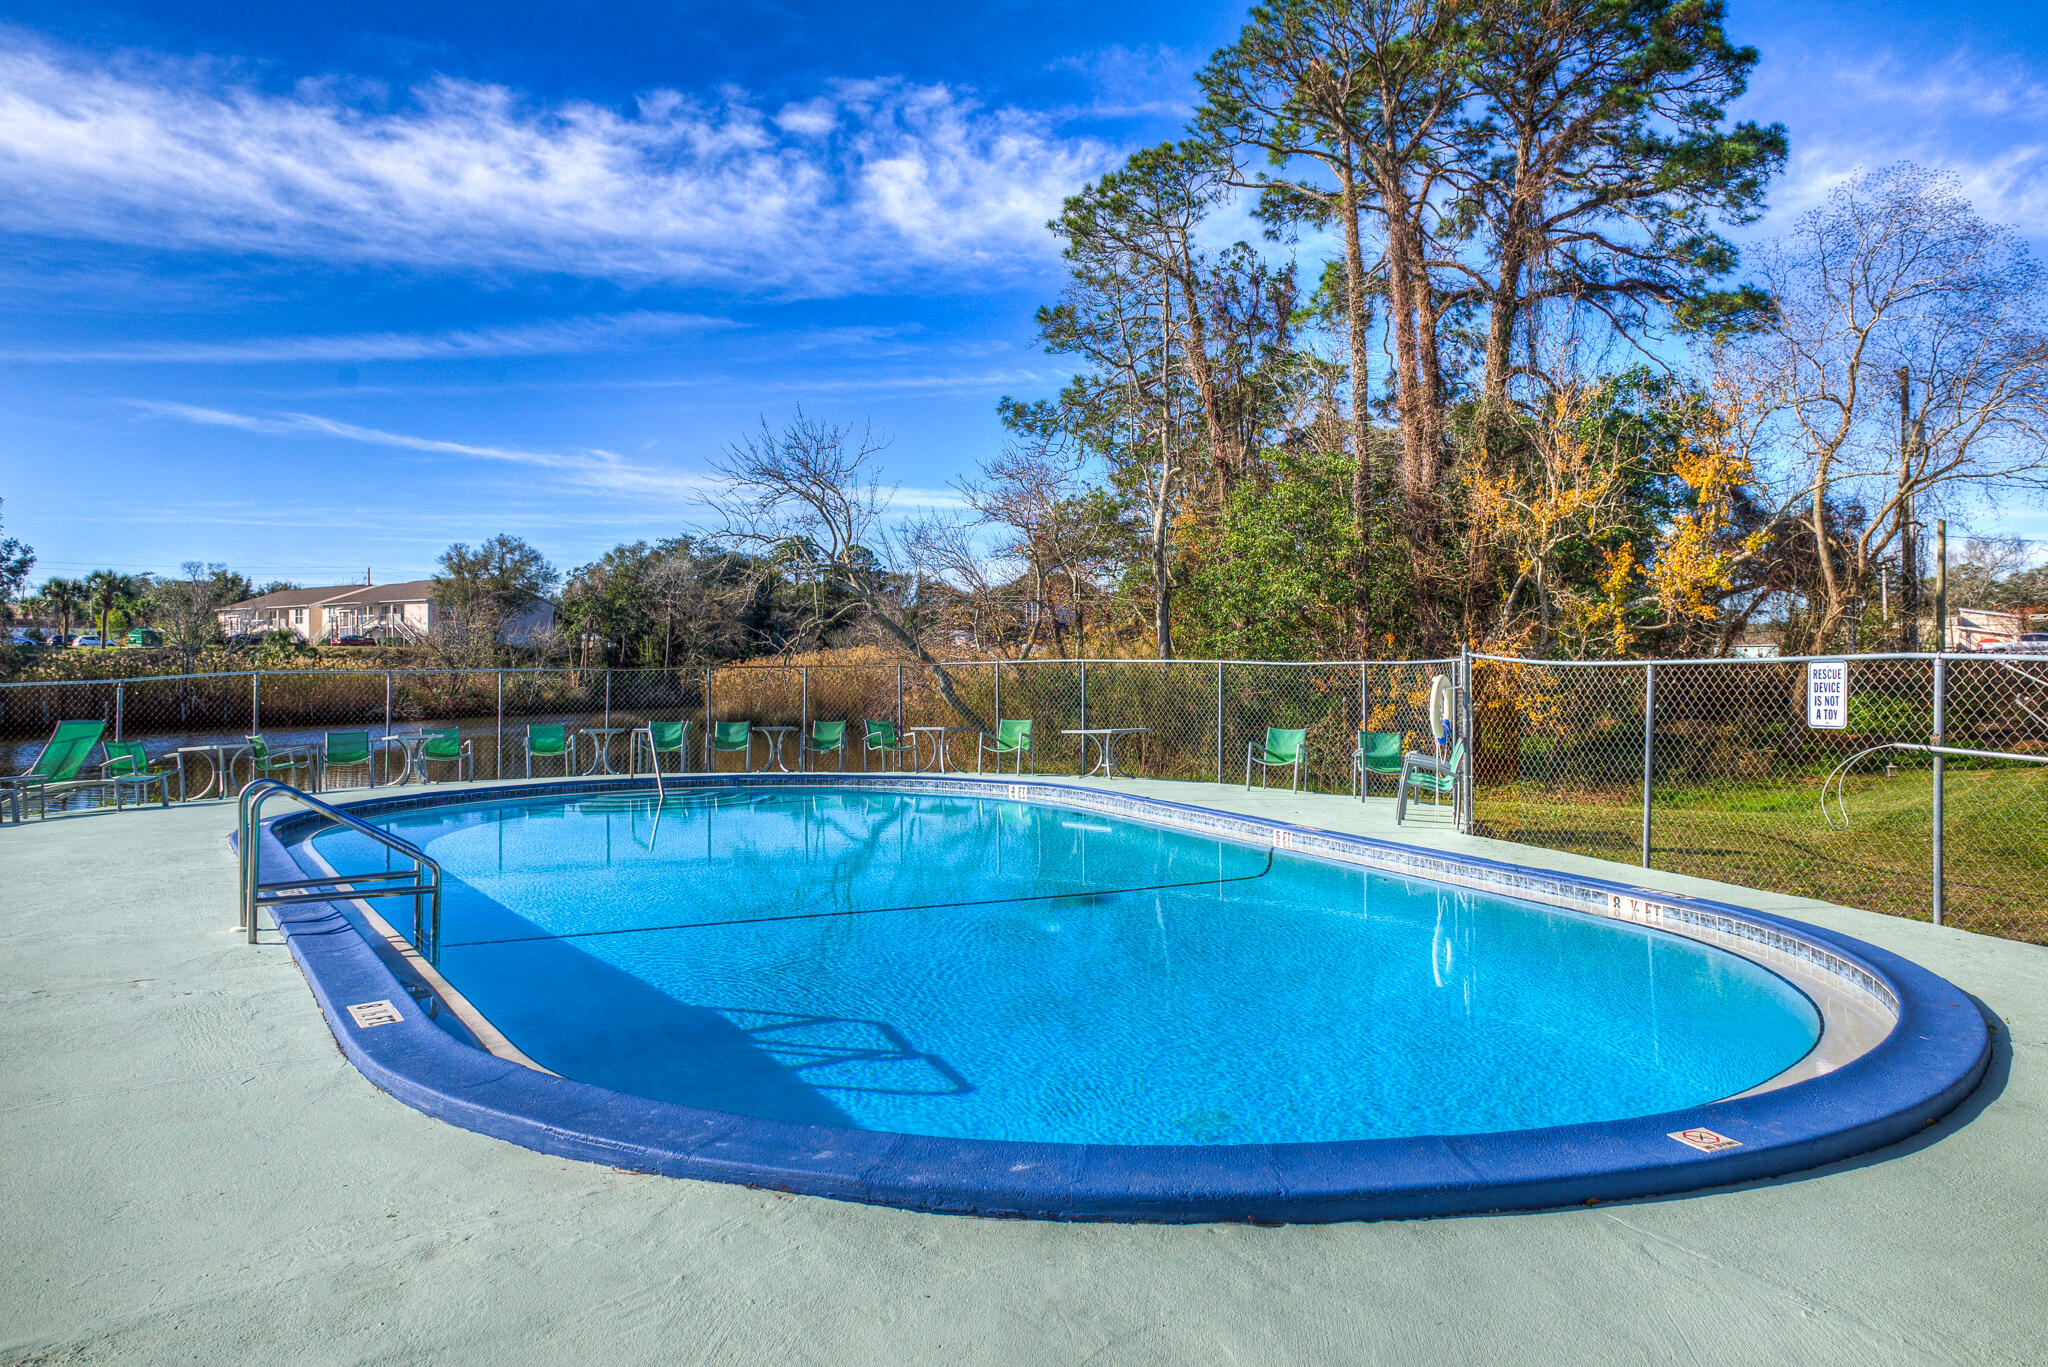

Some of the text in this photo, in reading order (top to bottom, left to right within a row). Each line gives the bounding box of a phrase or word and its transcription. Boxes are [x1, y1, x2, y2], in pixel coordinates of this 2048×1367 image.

[1813, 669, 1842, 680] RESCUE
[1813, 682, 1841, 693] DEVICE
[1814, 695, 1840, 707] IS NOT
[1816, 709, 1838, 720] A TOY
[1282, 831, 1291, 841] FT
[1613, 896, 1621, 909] 8
[1645, 902, 1661, 916] FT
